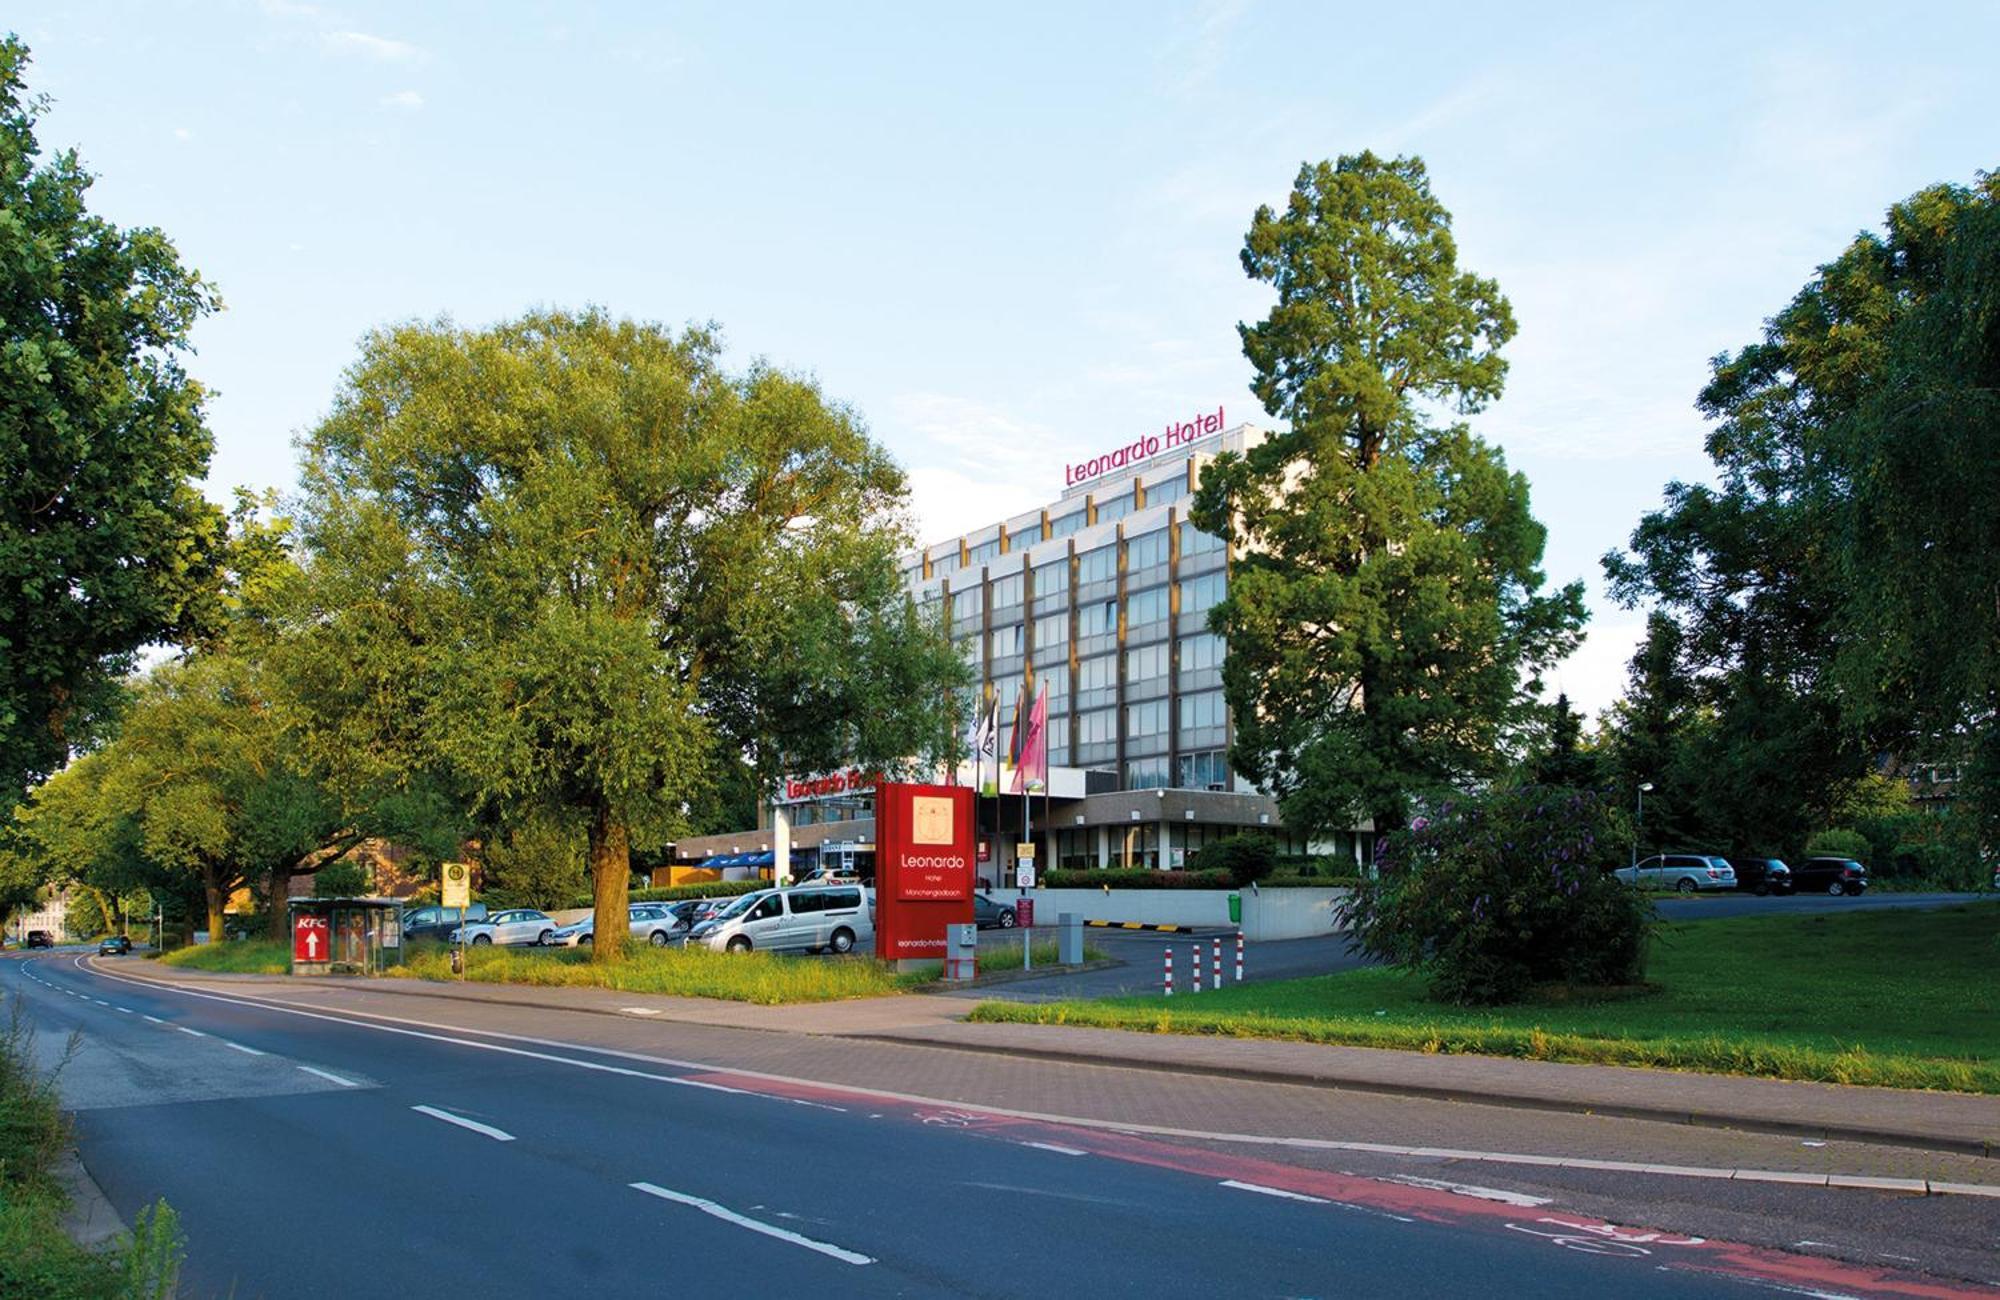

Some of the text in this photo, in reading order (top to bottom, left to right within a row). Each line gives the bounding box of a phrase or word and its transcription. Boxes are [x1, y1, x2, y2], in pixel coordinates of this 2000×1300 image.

[1066, 405, 1224, 486] Leonardo Hotel
[901, 853, 965, 869] Leonardo
[298, 918, 327, 928] KFC
